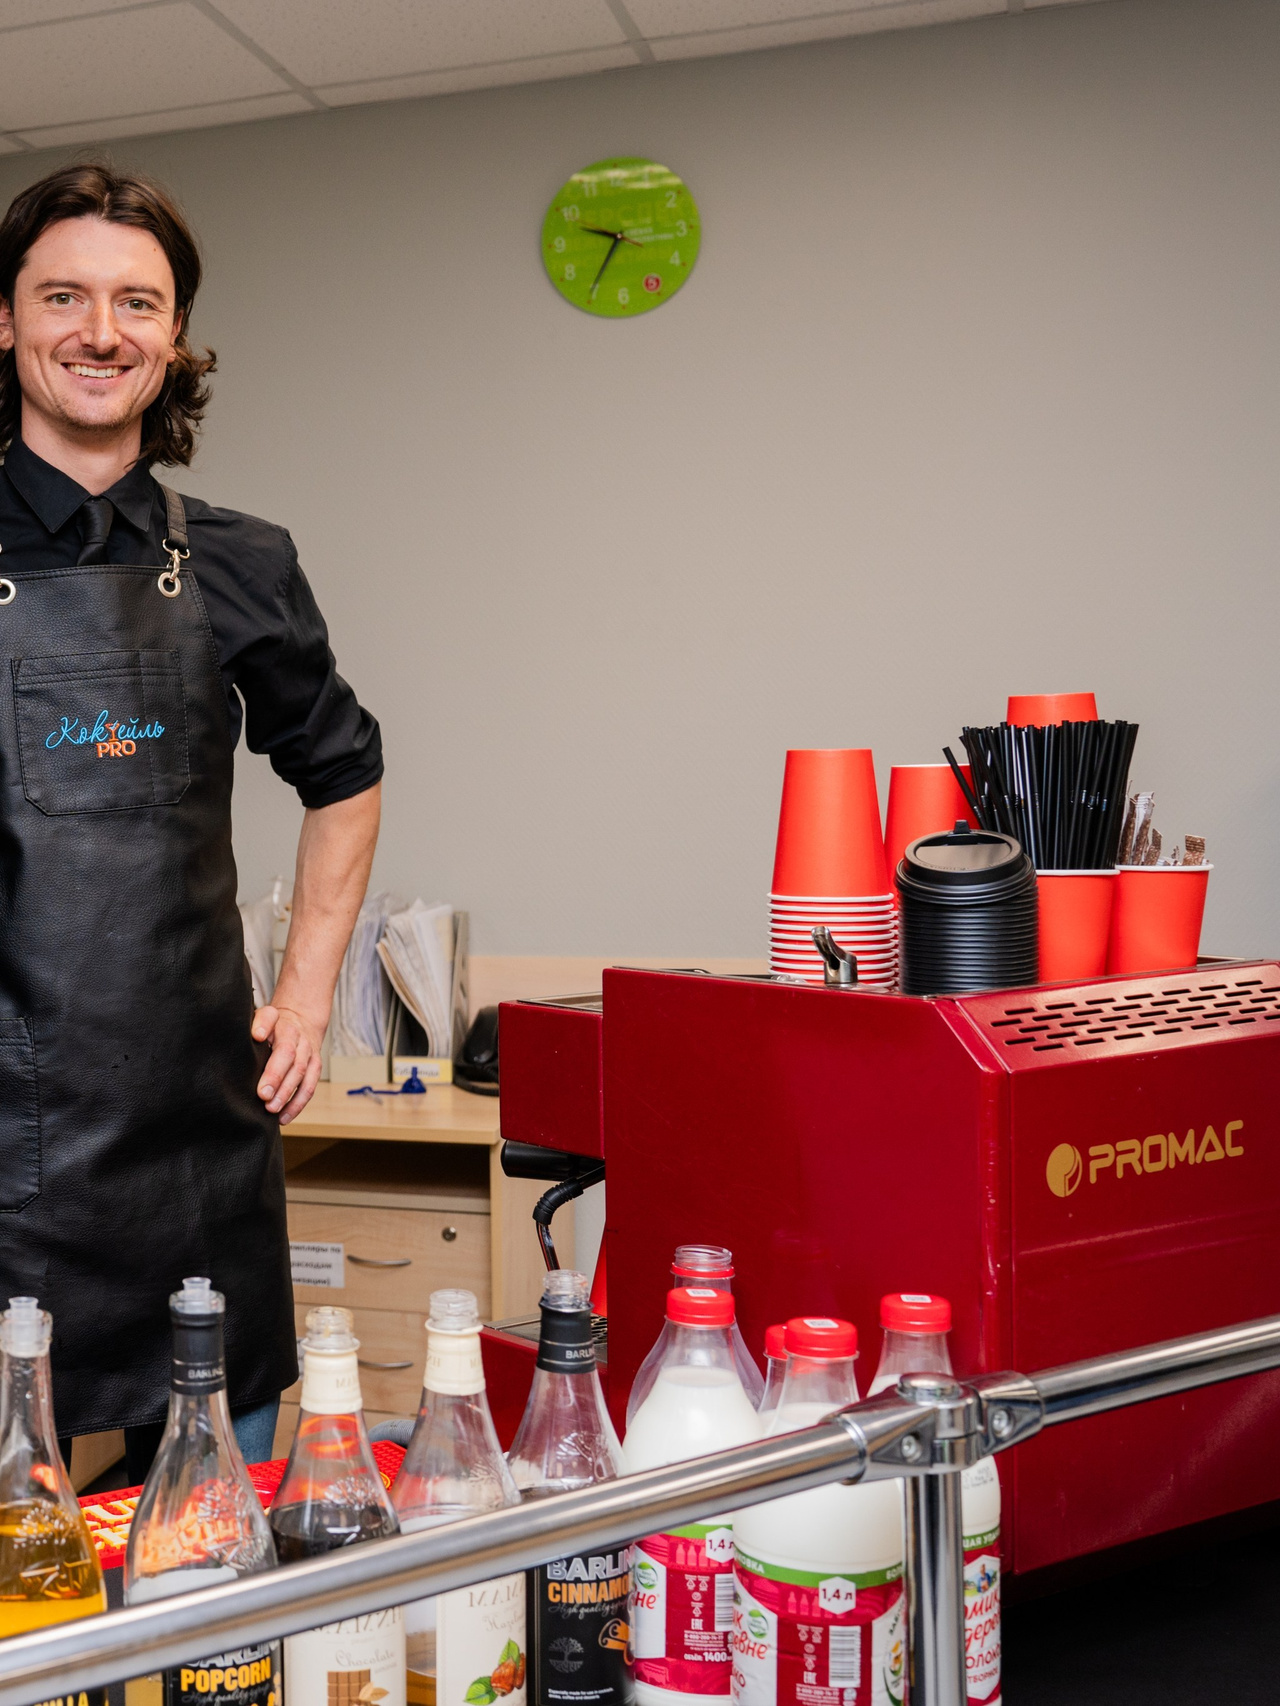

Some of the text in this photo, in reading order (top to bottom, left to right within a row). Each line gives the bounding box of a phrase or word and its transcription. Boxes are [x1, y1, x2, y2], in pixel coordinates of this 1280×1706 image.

[665, 191, 677, 208] 2
[562, 204, 580, 222] 10
[676, 219, 687, 237] 3
[554, 236, 566, 253] 9
[669, 250, 681, 266] 4
[564, 264, 576, 281] 8
[618, 287, 629, 305] 6
[96, 739, 137, 758] PRO
[1088, 1119, 1244, 1185] PROMAC
[708, 1538, 725, 1552] 1,4
[822, 1588, 853, 1602] 1,4 л
[703, 1651, 727, 1662] 1400
[180, 1656, 271, 1693] POPCORN
